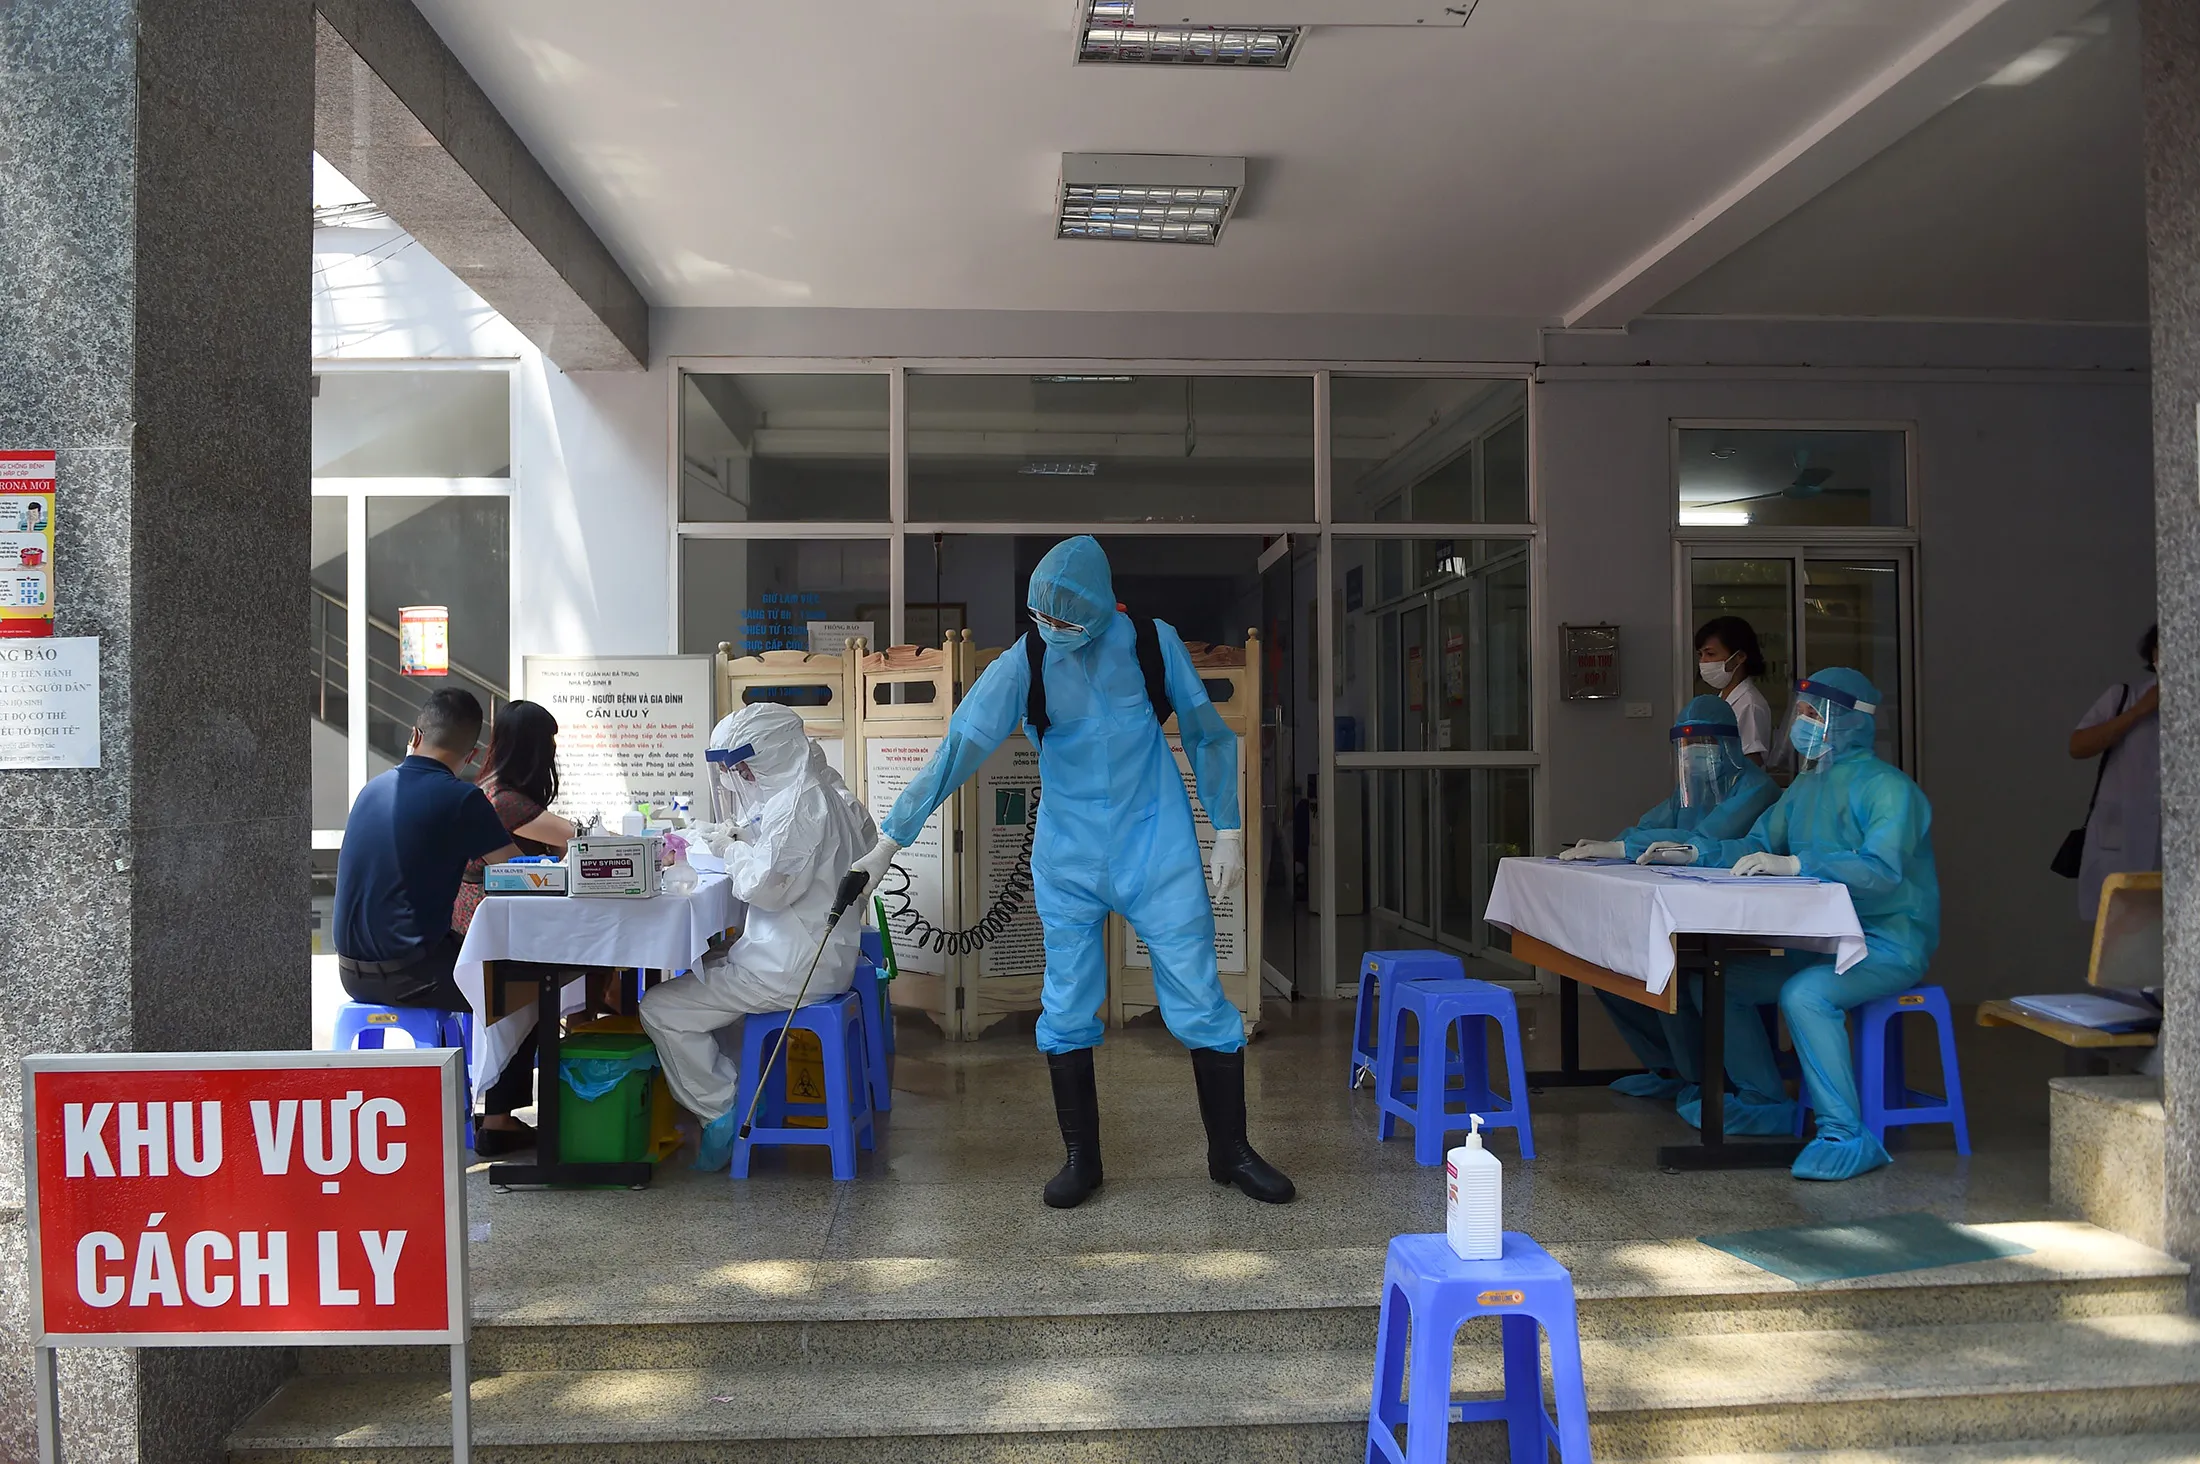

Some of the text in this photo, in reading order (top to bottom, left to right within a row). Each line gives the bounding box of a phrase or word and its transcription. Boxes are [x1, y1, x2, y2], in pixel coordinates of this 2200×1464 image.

[30, 480, 51, 490] MỚI
[24, 645, 58, 662] BÁO
[44, 668, 72, 678] HÀNH
[28, 682, 63, 693] NGƯỜI
[24, 699, 43, 707] SINH
[552, 692, 683, 706] SẢN PHỤ NGƯỜI BỆNH VÀ GIA ĐÌNH
[28, 711, 44, 721] CƠ
[586, 707, 649, 718] CẦN LƯU Ý
[34, 726, 59, 738] DỊCH
[681, 723, 694, 731] phải
[642, 732, 653, 740] tiếp
[646, 761, 664, 769] Phòng
[667, 771, 677, 779] ghi
[679, 771, 694, 779] đúng
[631, 790, 649, 798] không
[653, 790, 666, 798] phải
[64, 1090, 407, 1194] KHU VỰC
[76, 1212, 408, 1308] CÁCH LY
